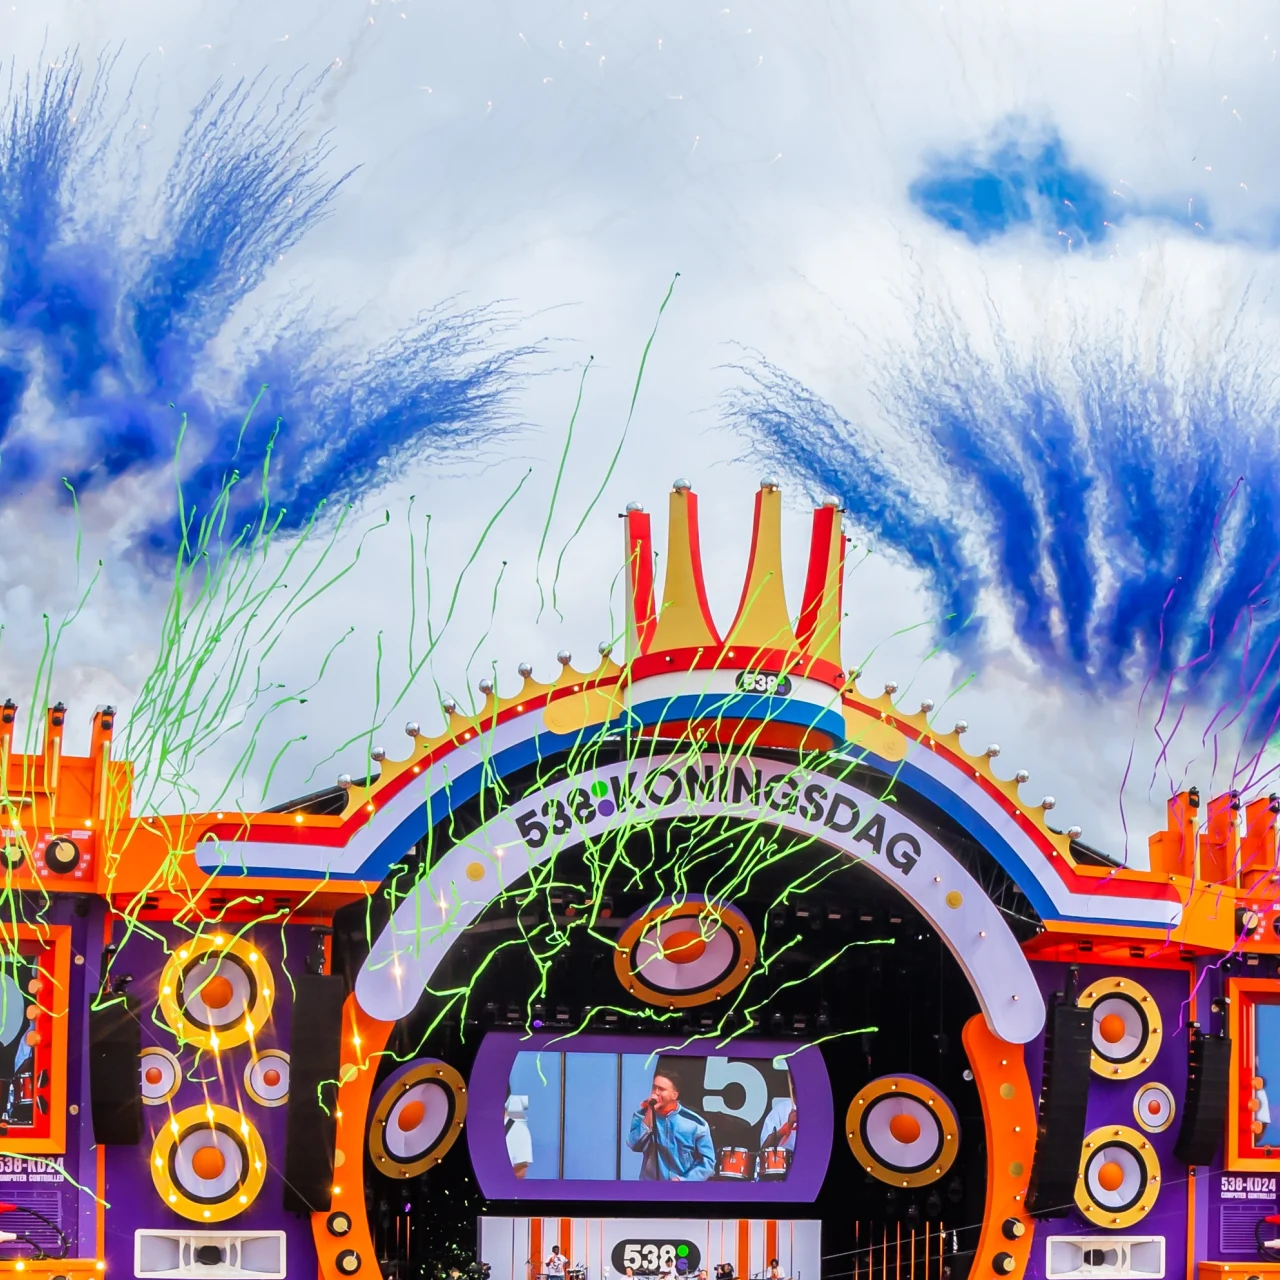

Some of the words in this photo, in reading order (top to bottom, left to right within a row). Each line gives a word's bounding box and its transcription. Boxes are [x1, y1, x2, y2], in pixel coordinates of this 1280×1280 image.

[743, 674, 780, 692] 538
[609, 765, 921, 876] KONINGSDAG
[1221, 1177, 1276, 1191] 538-KD24
[624, 1244, 677, 1271] 538
